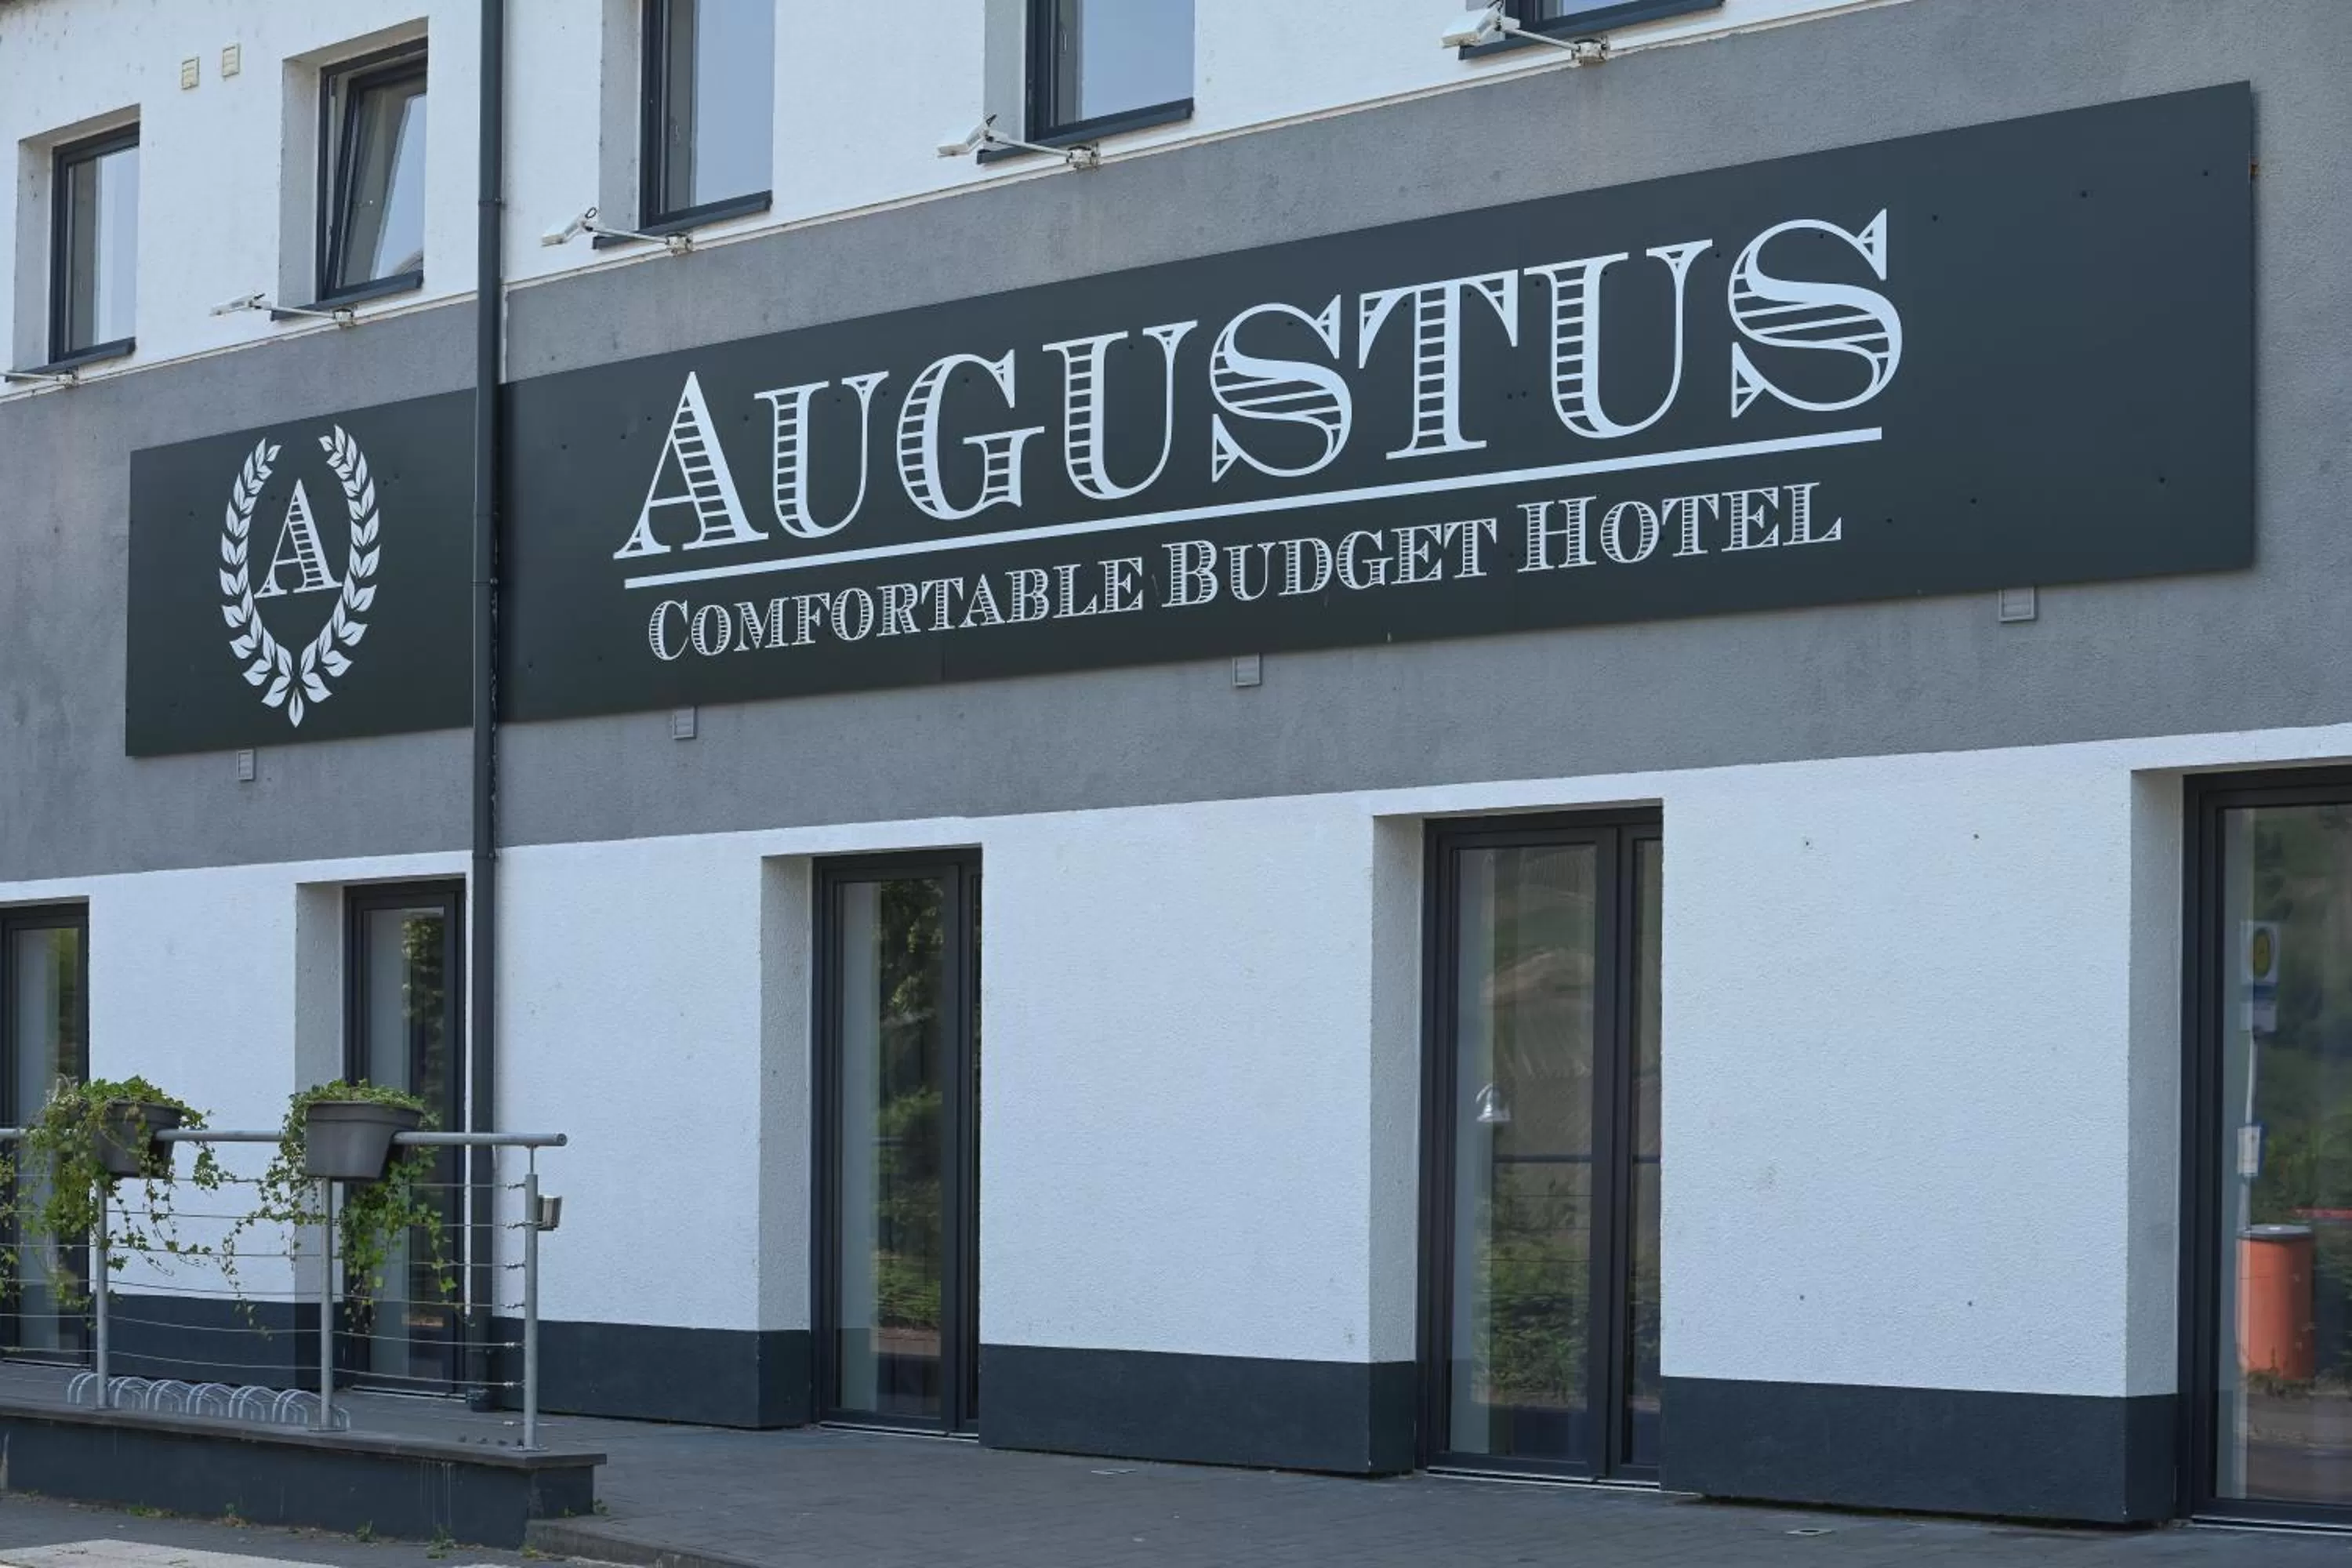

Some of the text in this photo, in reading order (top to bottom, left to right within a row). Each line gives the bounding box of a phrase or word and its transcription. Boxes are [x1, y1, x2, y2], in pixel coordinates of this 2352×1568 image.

[613, 209, 1902, 560] AUGUSTUS
[254, 479, 343, 600] A
[648, 482, 1842, 661] COMFORTABLE BUDGET HOTEL
